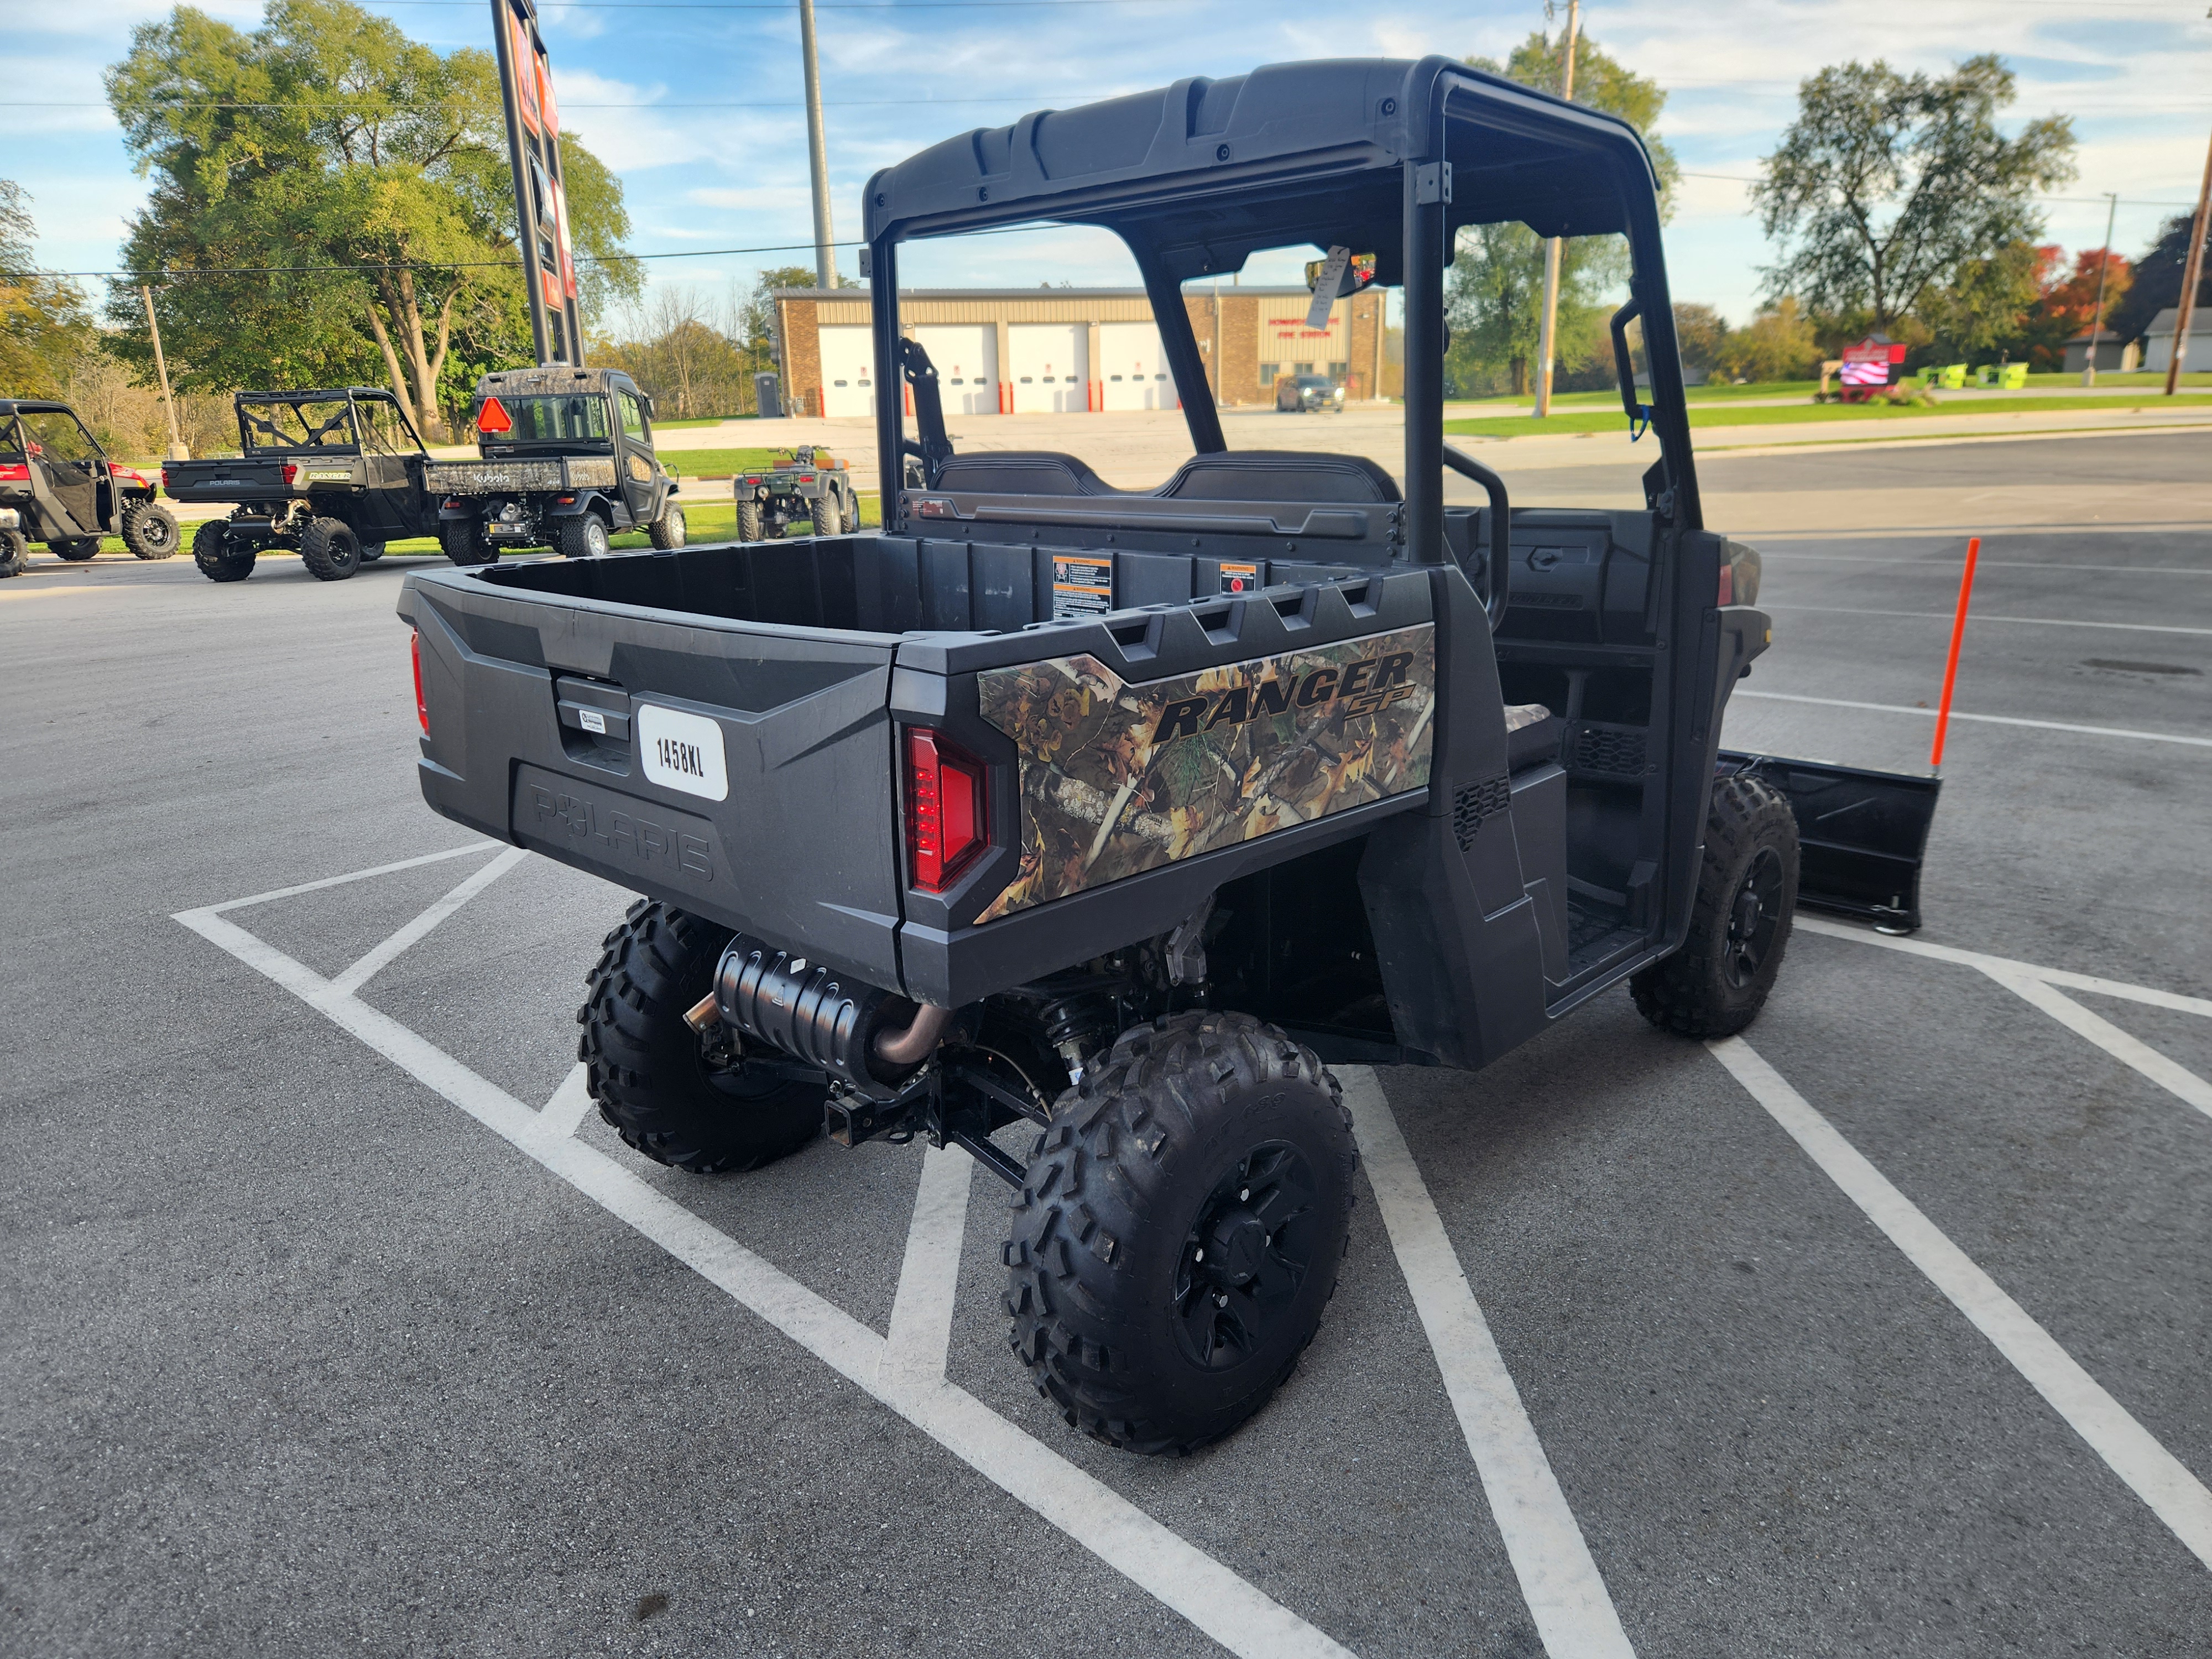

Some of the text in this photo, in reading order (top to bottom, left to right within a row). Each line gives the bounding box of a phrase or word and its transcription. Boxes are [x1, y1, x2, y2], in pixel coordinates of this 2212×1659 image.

[473, 473, 510, 483] Kubota
[1149, 650, 1416, 746] RANGER
[1344, 684, 1416, 720] SP
[530, 784, 714, 882] POLARIS
